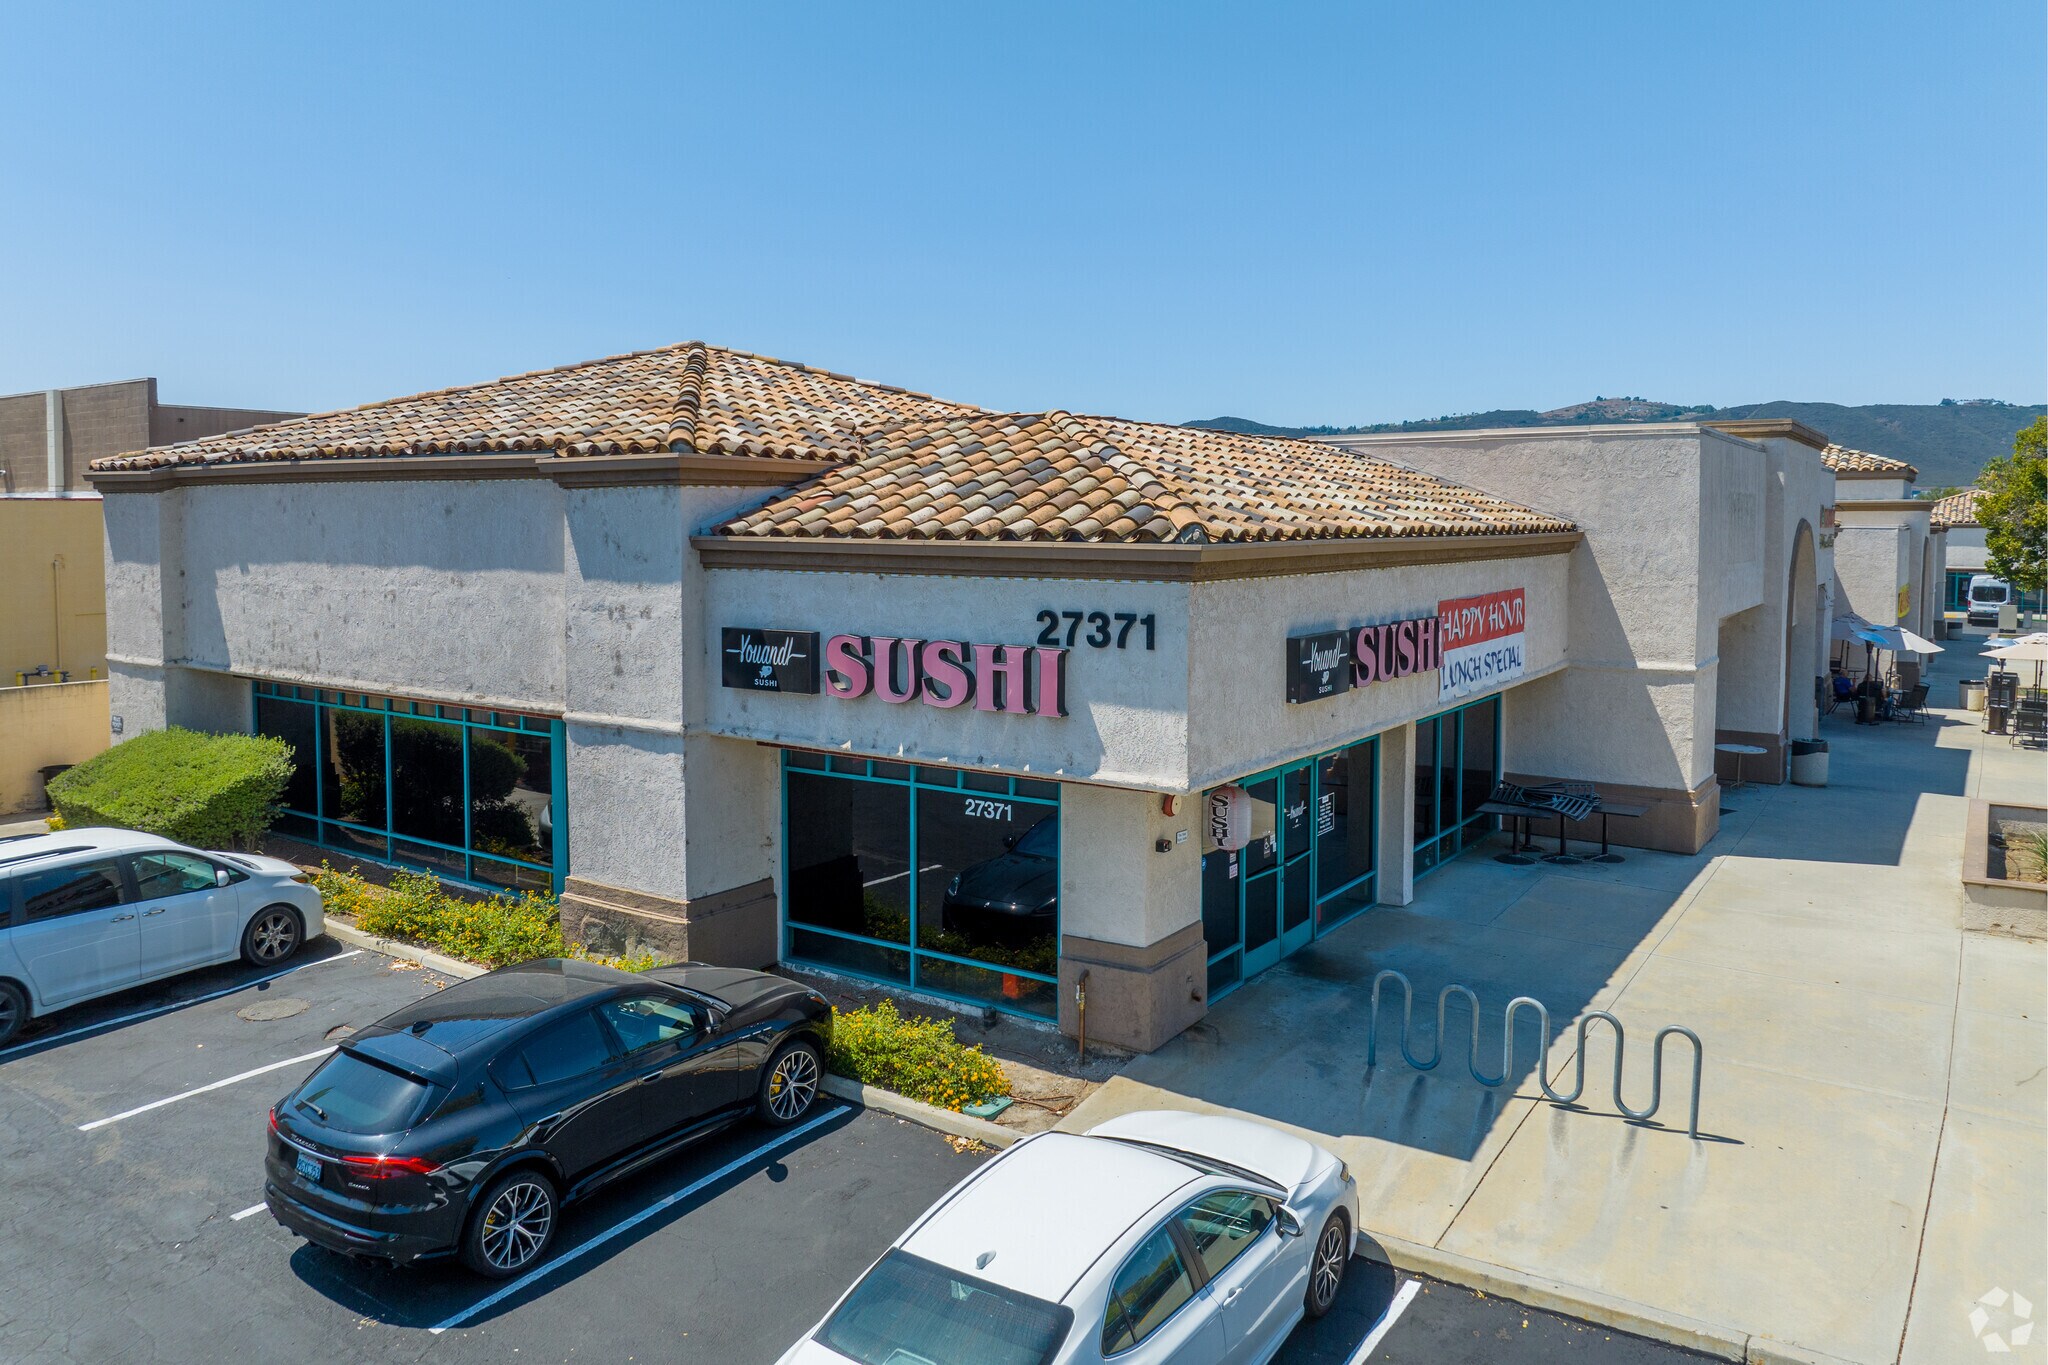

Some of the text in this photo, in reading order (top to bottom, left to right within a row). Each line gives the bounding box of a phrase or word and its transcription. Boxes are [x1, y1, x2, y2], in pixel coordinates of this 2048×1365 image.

[1036, 610, 1156, 650] 27371
[1442, 606, 1486, 642] HAPPY
[1356, 616, 1445, 687] SUSHI
[1441, 645, 1522, 690] LUNCH SPECIAL
[754, 678, 778, 687] SUSHI
[824, 634, 1069, 718] SUSHI
[1318, 684, 1333, 694] SUSHI
[964, 798, 1013, 822] 27371
[1211, 794, 1229, 847] SUSHI
